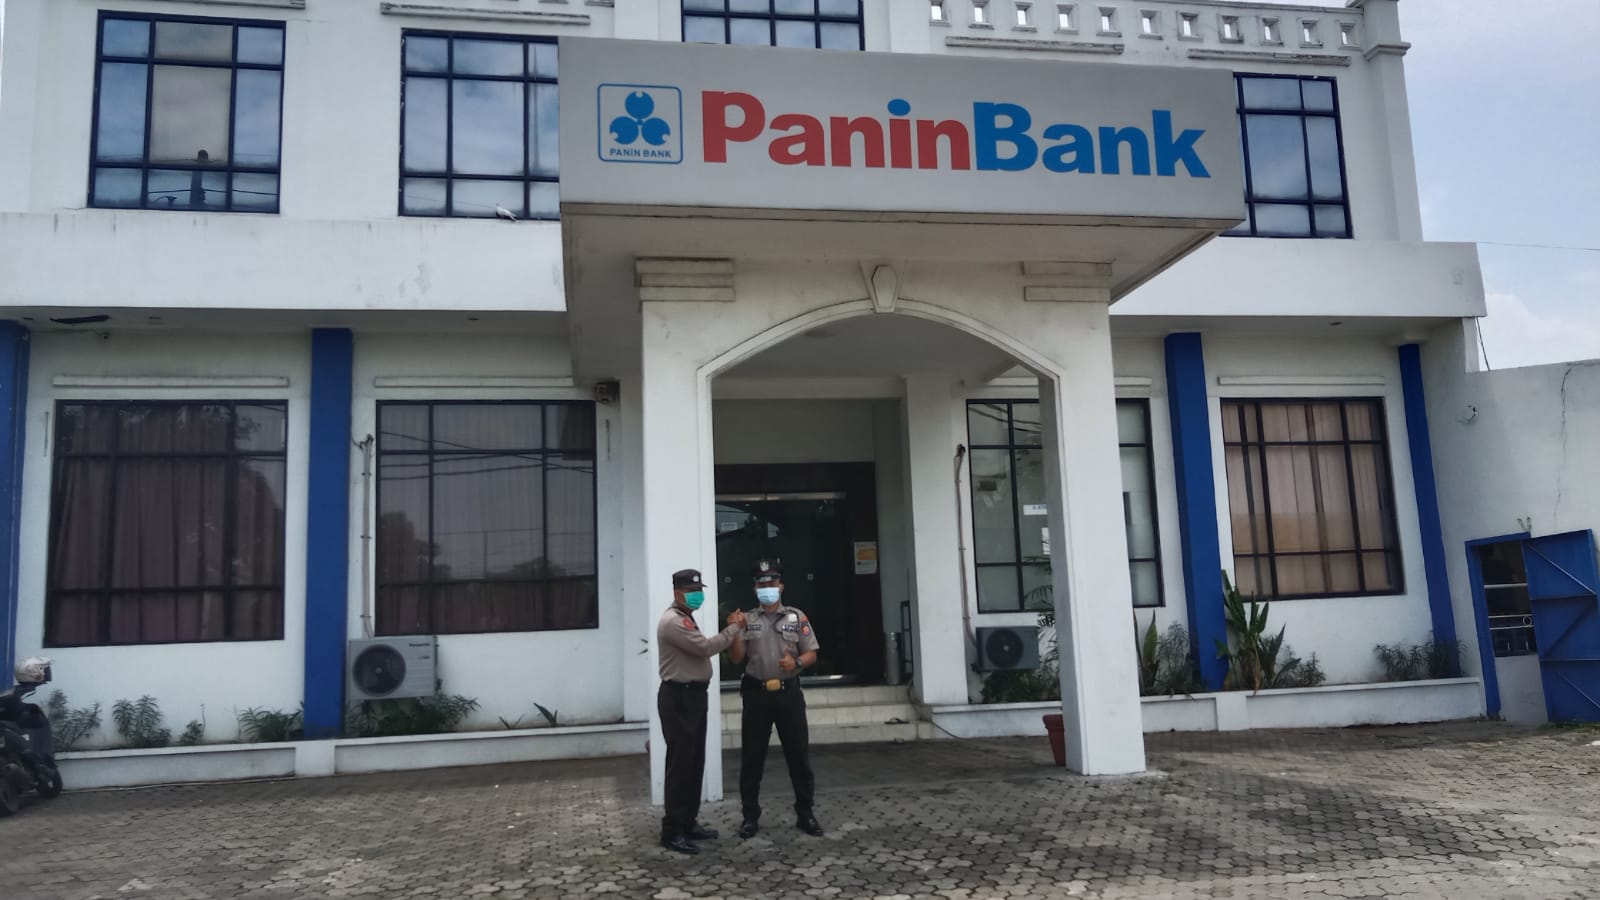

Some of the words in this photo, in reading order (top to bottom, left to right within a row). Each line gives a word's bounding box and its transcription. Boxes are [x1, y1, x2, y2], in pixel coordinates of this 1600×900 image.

[609, 148, 641, 157] PANIN
[643, 149, 672, 158] BANK
[702, 90, 1211, 178] PaninBank
